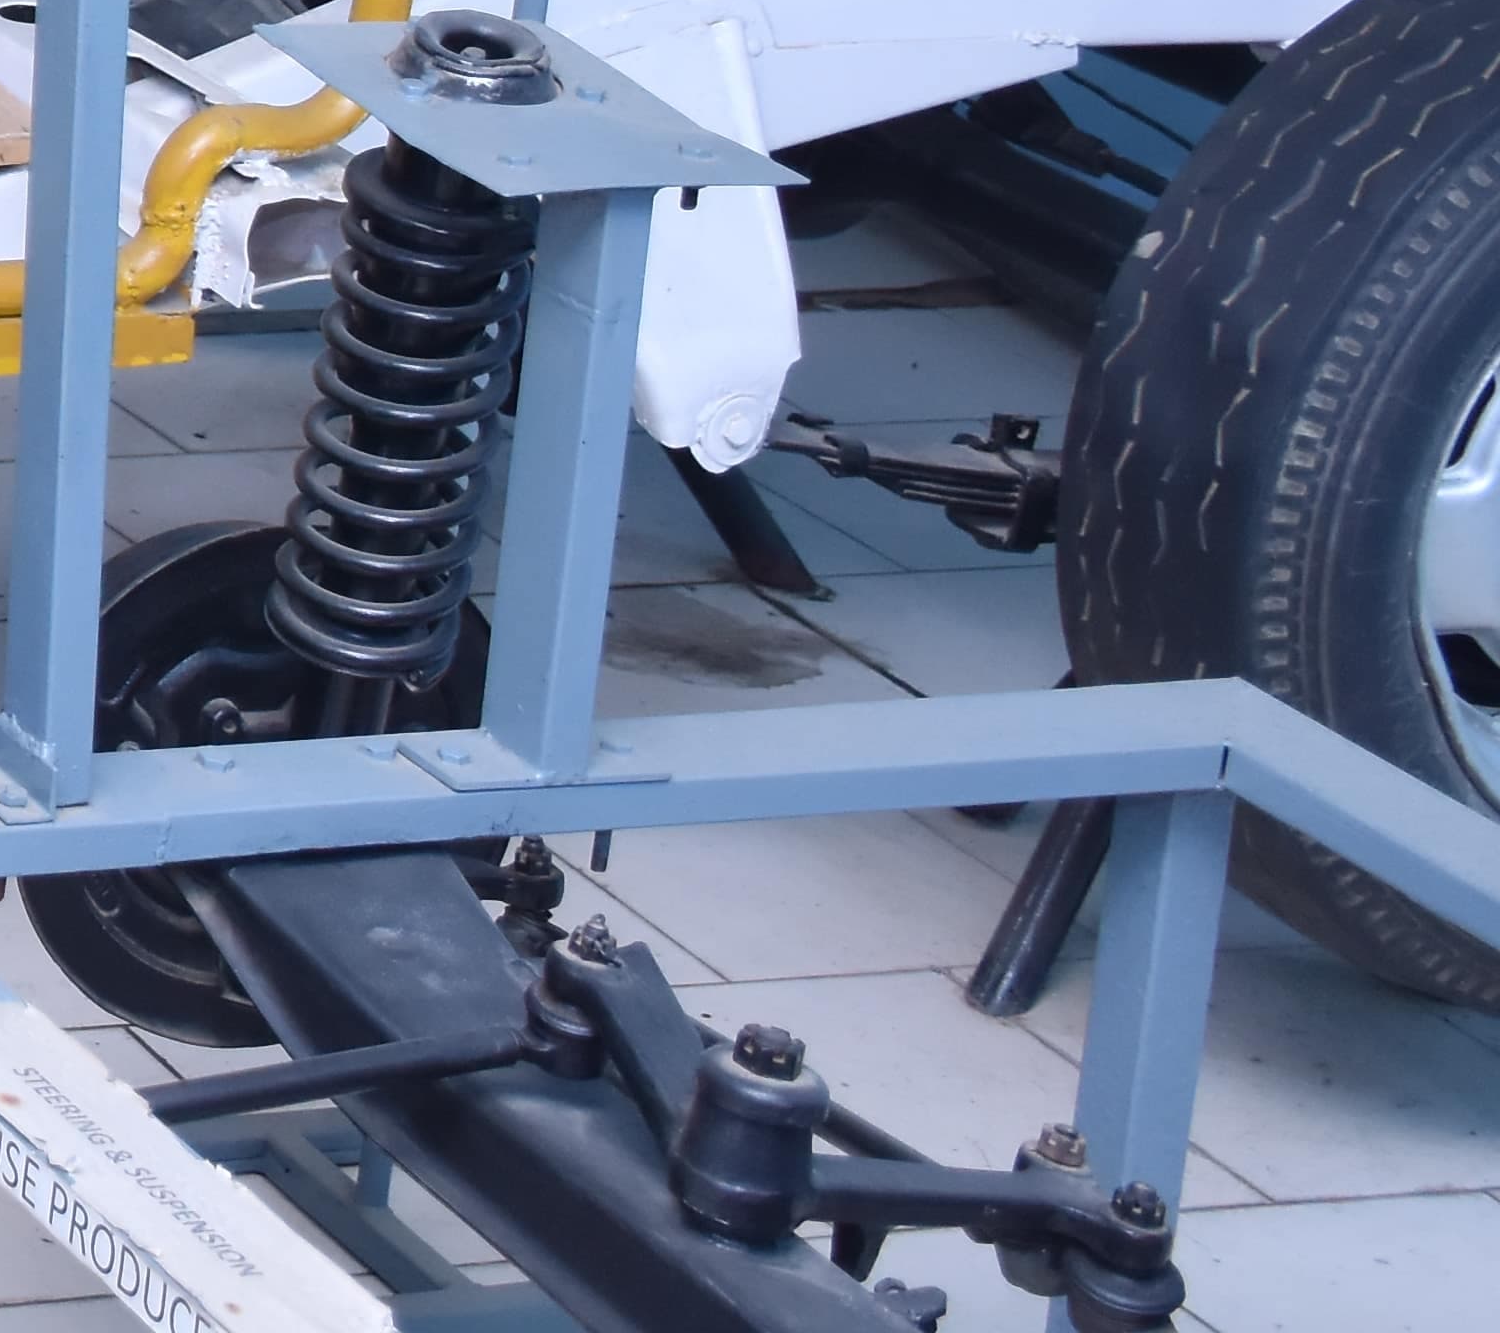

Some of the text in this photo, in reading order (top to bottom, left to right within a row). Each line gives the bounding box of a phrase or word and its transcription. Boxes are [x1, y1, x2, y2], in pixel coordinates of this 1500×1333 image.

[13, 1065, 264, 1277] STEERING & SUSPENSION
